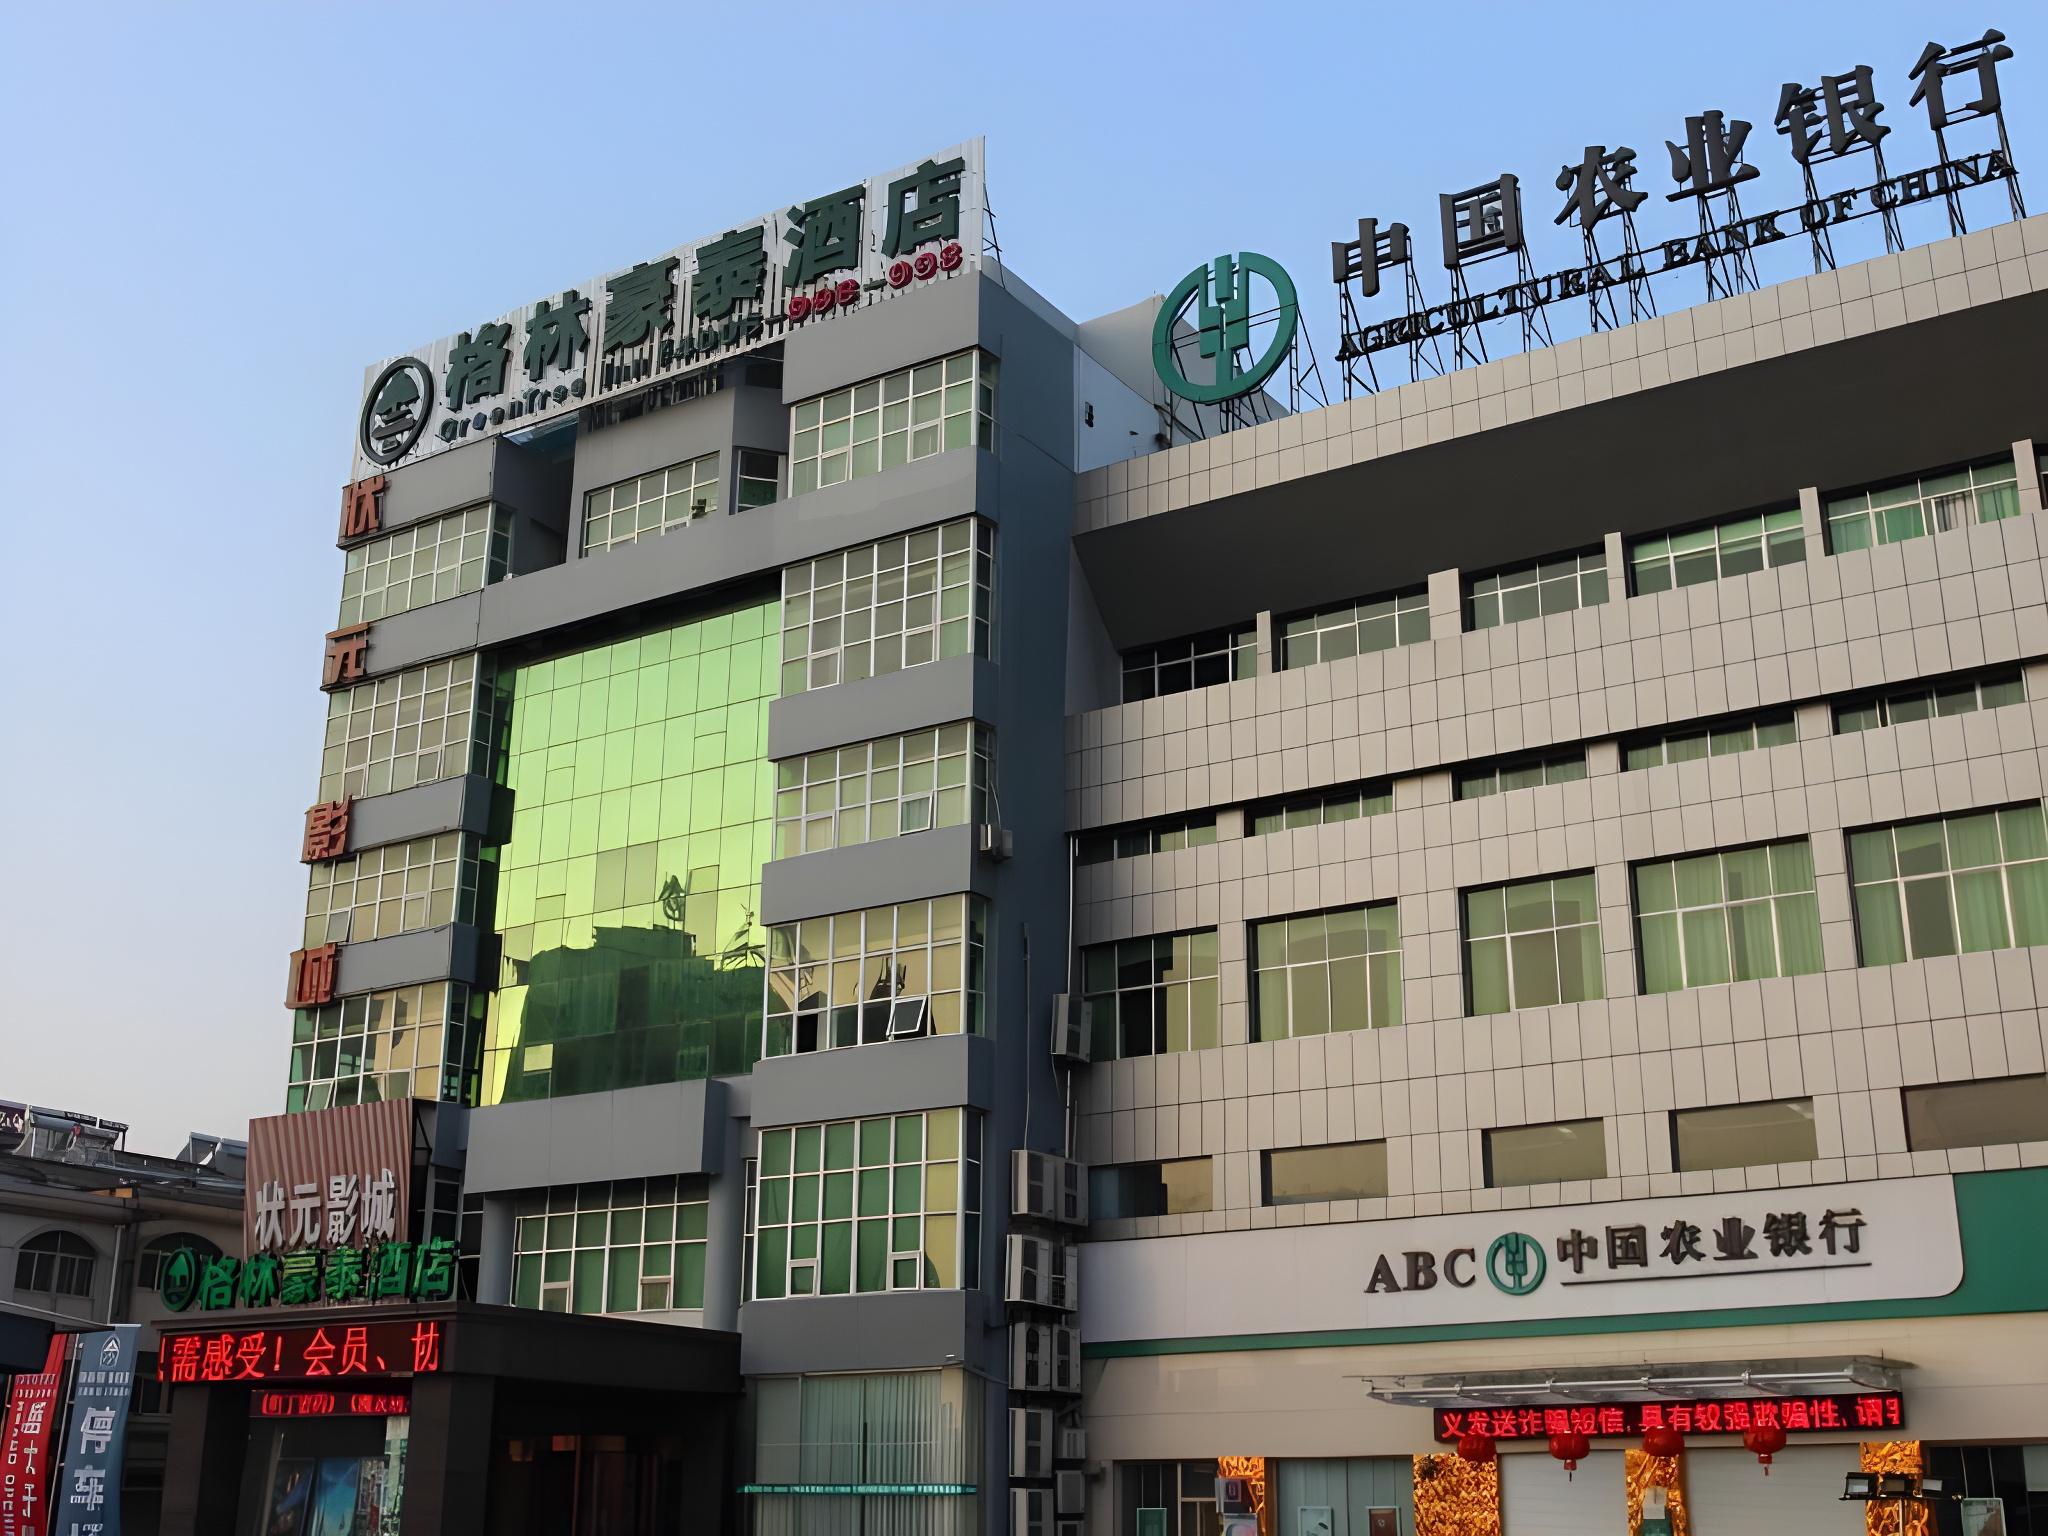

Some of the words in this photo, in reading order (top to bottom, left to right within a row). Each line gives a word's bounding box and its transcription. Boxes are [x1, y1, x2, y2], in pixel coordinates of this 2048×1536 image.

[1331, 29, 2014, 298] 中国农业银行
[445, 157, 965, 413] 格林豪泰酒店
[1336, 253, 1646, 361] AGRICULTURAL
[1663, 210, 1787, 269] BANK
[1800, 188, 1857, 231] OF
[1870, 149, 2019, 208] CHINA
[255, 1168, 396, 1250] 状元影城
[1557, 1208, 1867, 1275] 中国农业银行
[200, 1236, 460, 1311] 格林豪泰酒店
[1364, 1247, 1476, 1293] ABC
